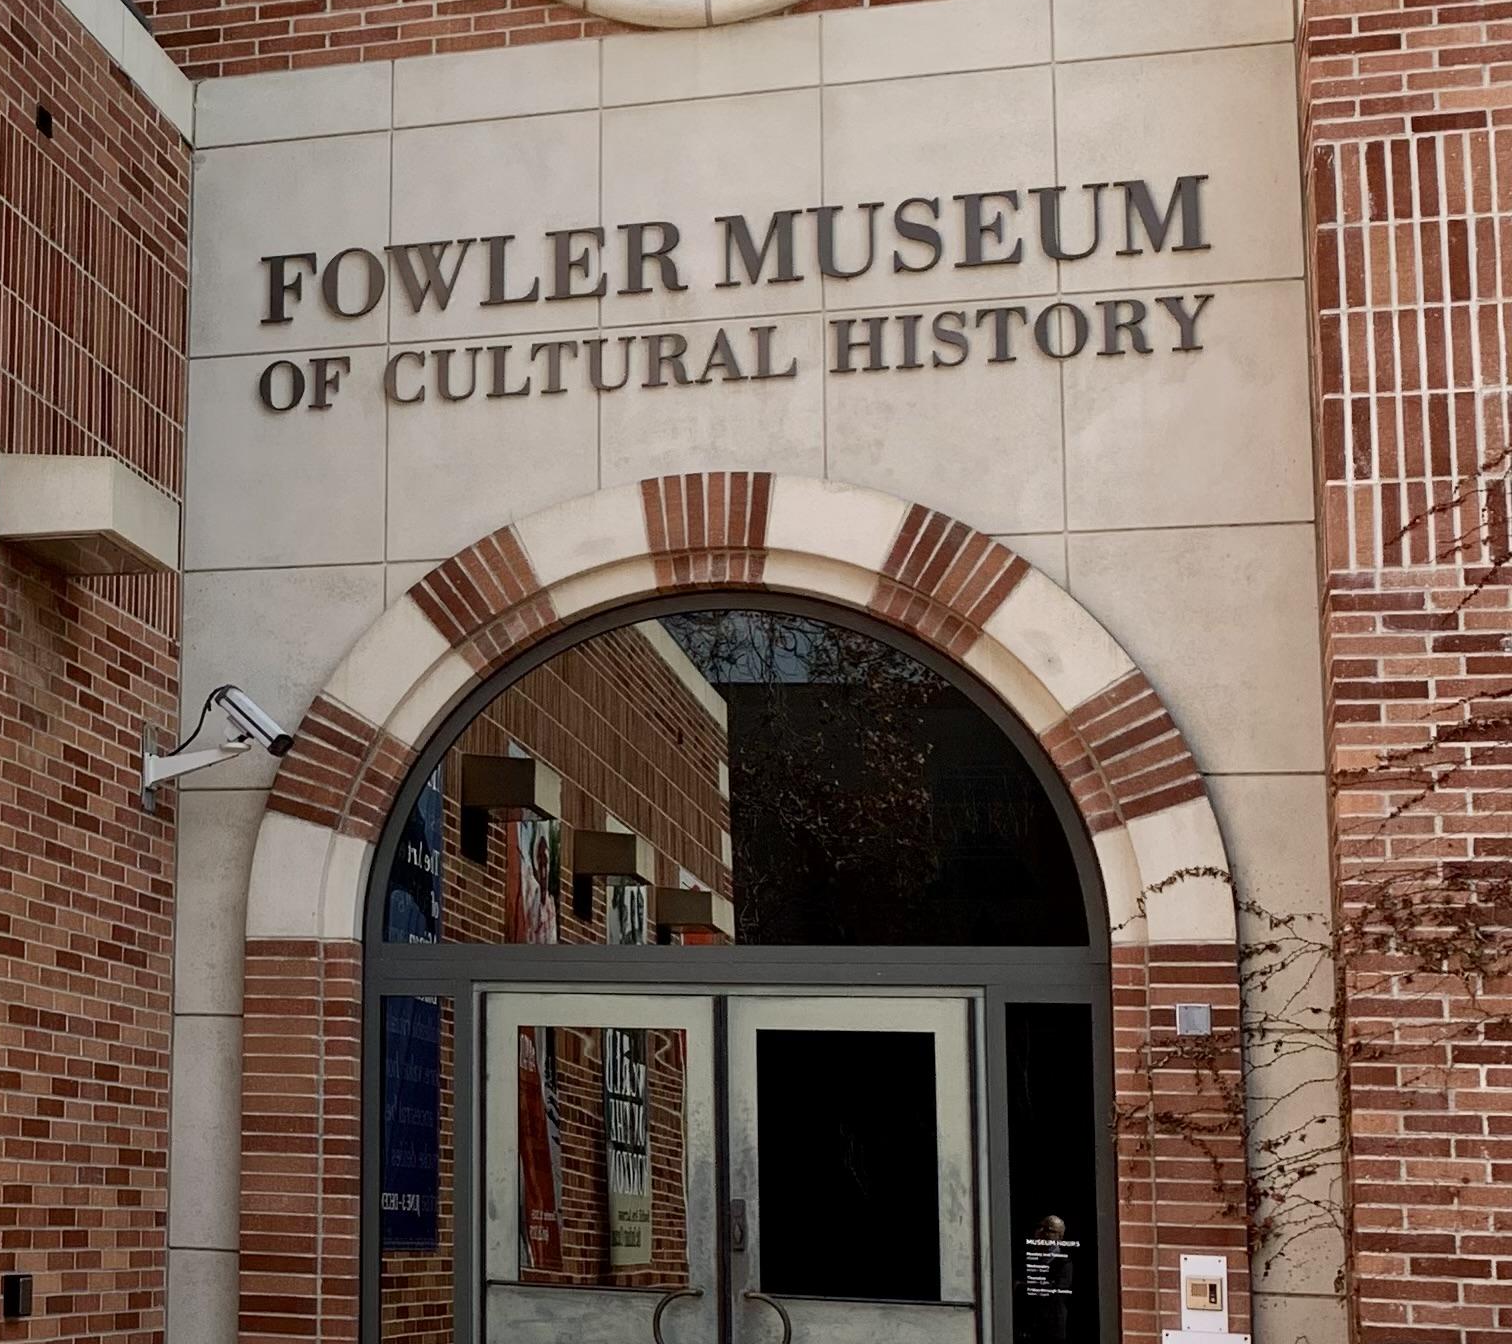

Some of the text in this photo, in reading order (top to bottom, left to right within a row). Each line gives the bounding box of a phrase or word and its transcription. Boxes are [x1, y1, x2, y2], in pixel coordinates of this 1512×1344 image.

[259, 174, 1212, 325] FOWLER MUSEUM
[259, 294, 1214, 412] OF CULTURAL HISTORY
